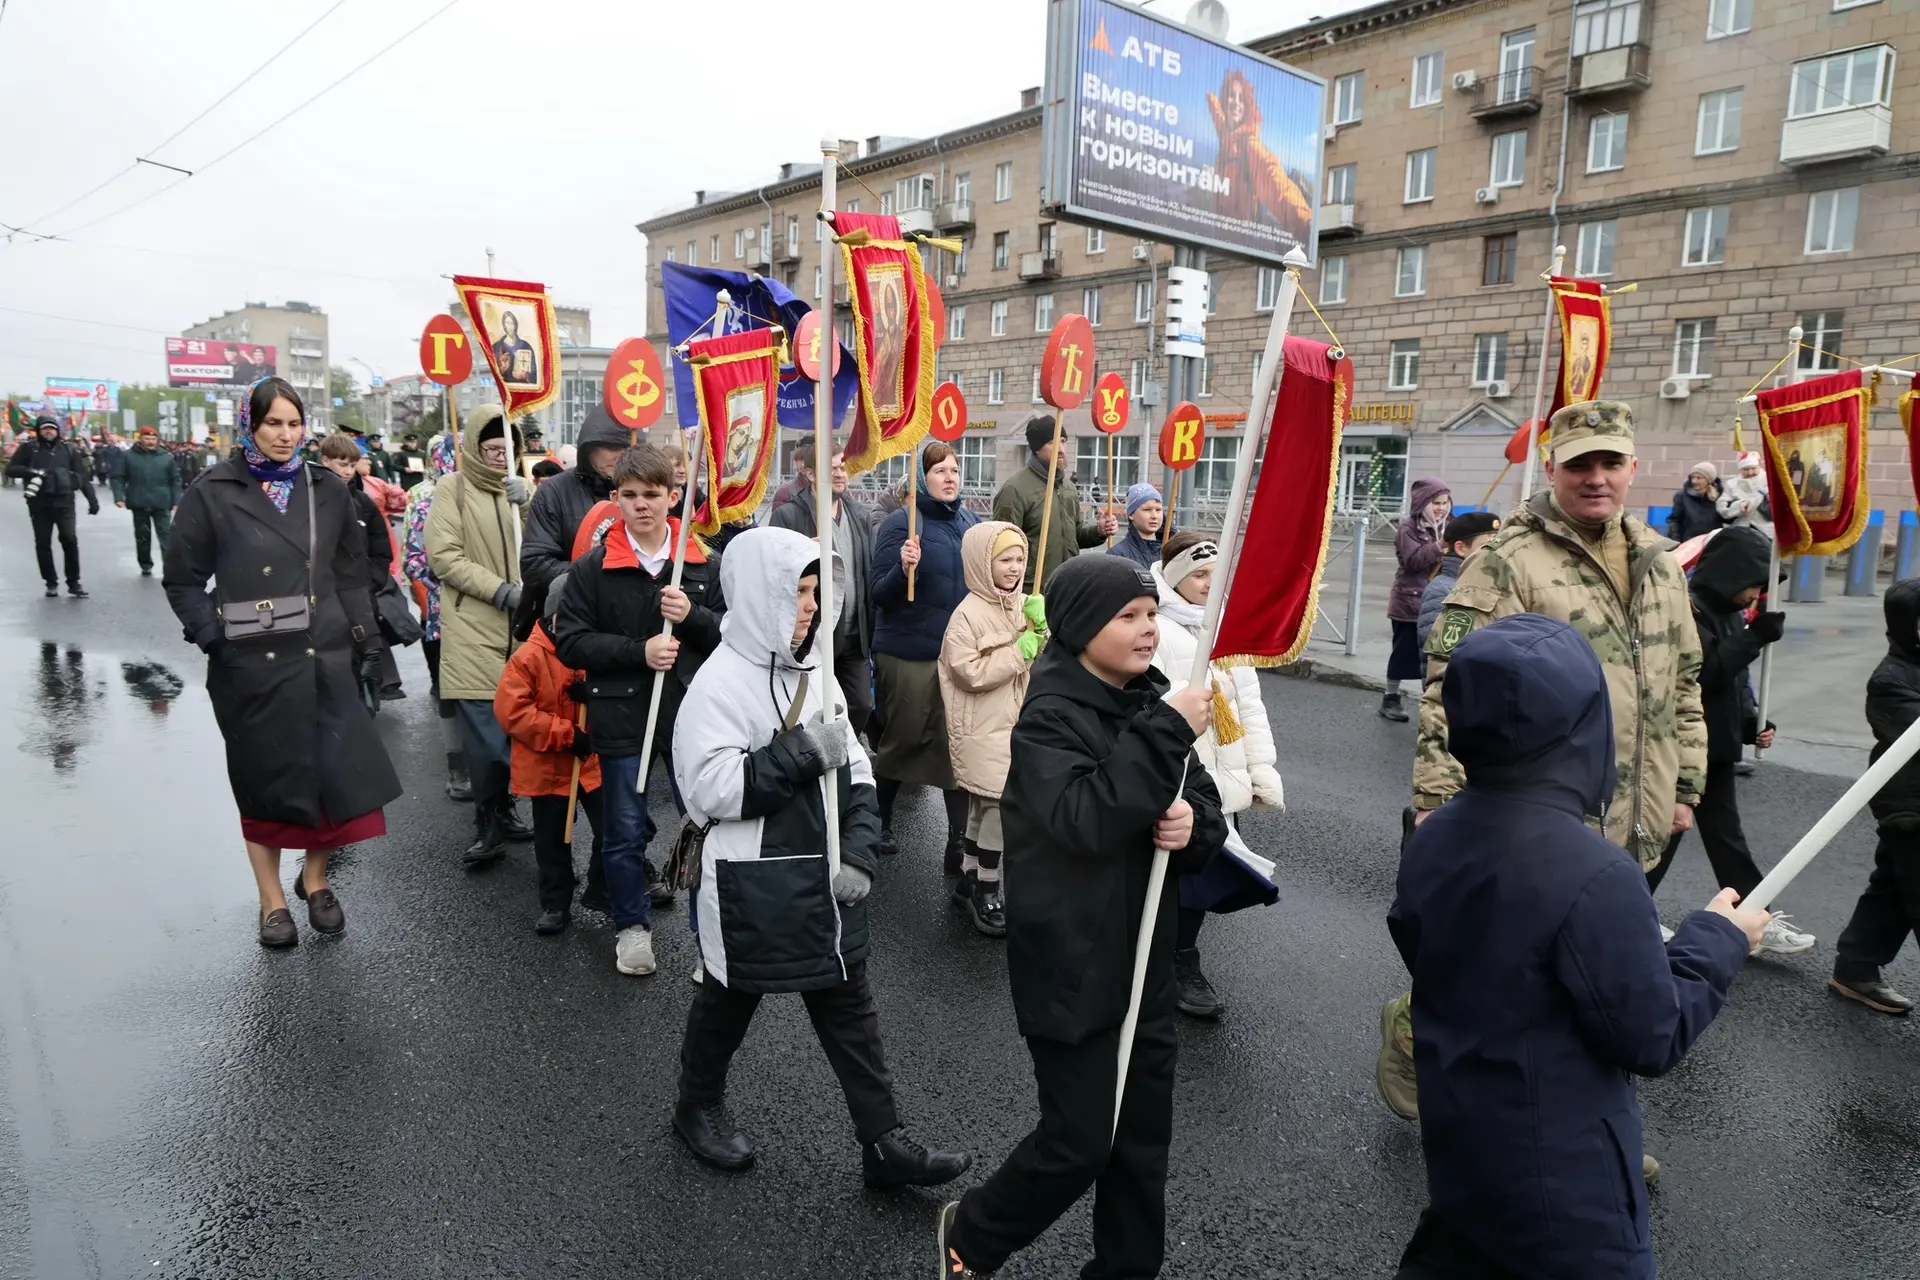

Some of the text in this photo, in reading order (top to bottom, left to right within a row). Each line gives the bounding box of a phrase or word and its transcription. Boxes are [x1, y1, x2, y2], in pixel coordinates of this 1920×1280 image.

[1121, 36, 1181, 76] АТБ
[1082, 72, 1179, 125] Вместе
[1105, 113, 1193, 159] новым
[1079, 136, 1230, 196] горизонтам
[173, 366, 230, 375] ФАКТОР-2
[430, 333, 464, 375] Г
[616, 359, 660, 420] Ф
[1172, 420, 1200, 462] К
